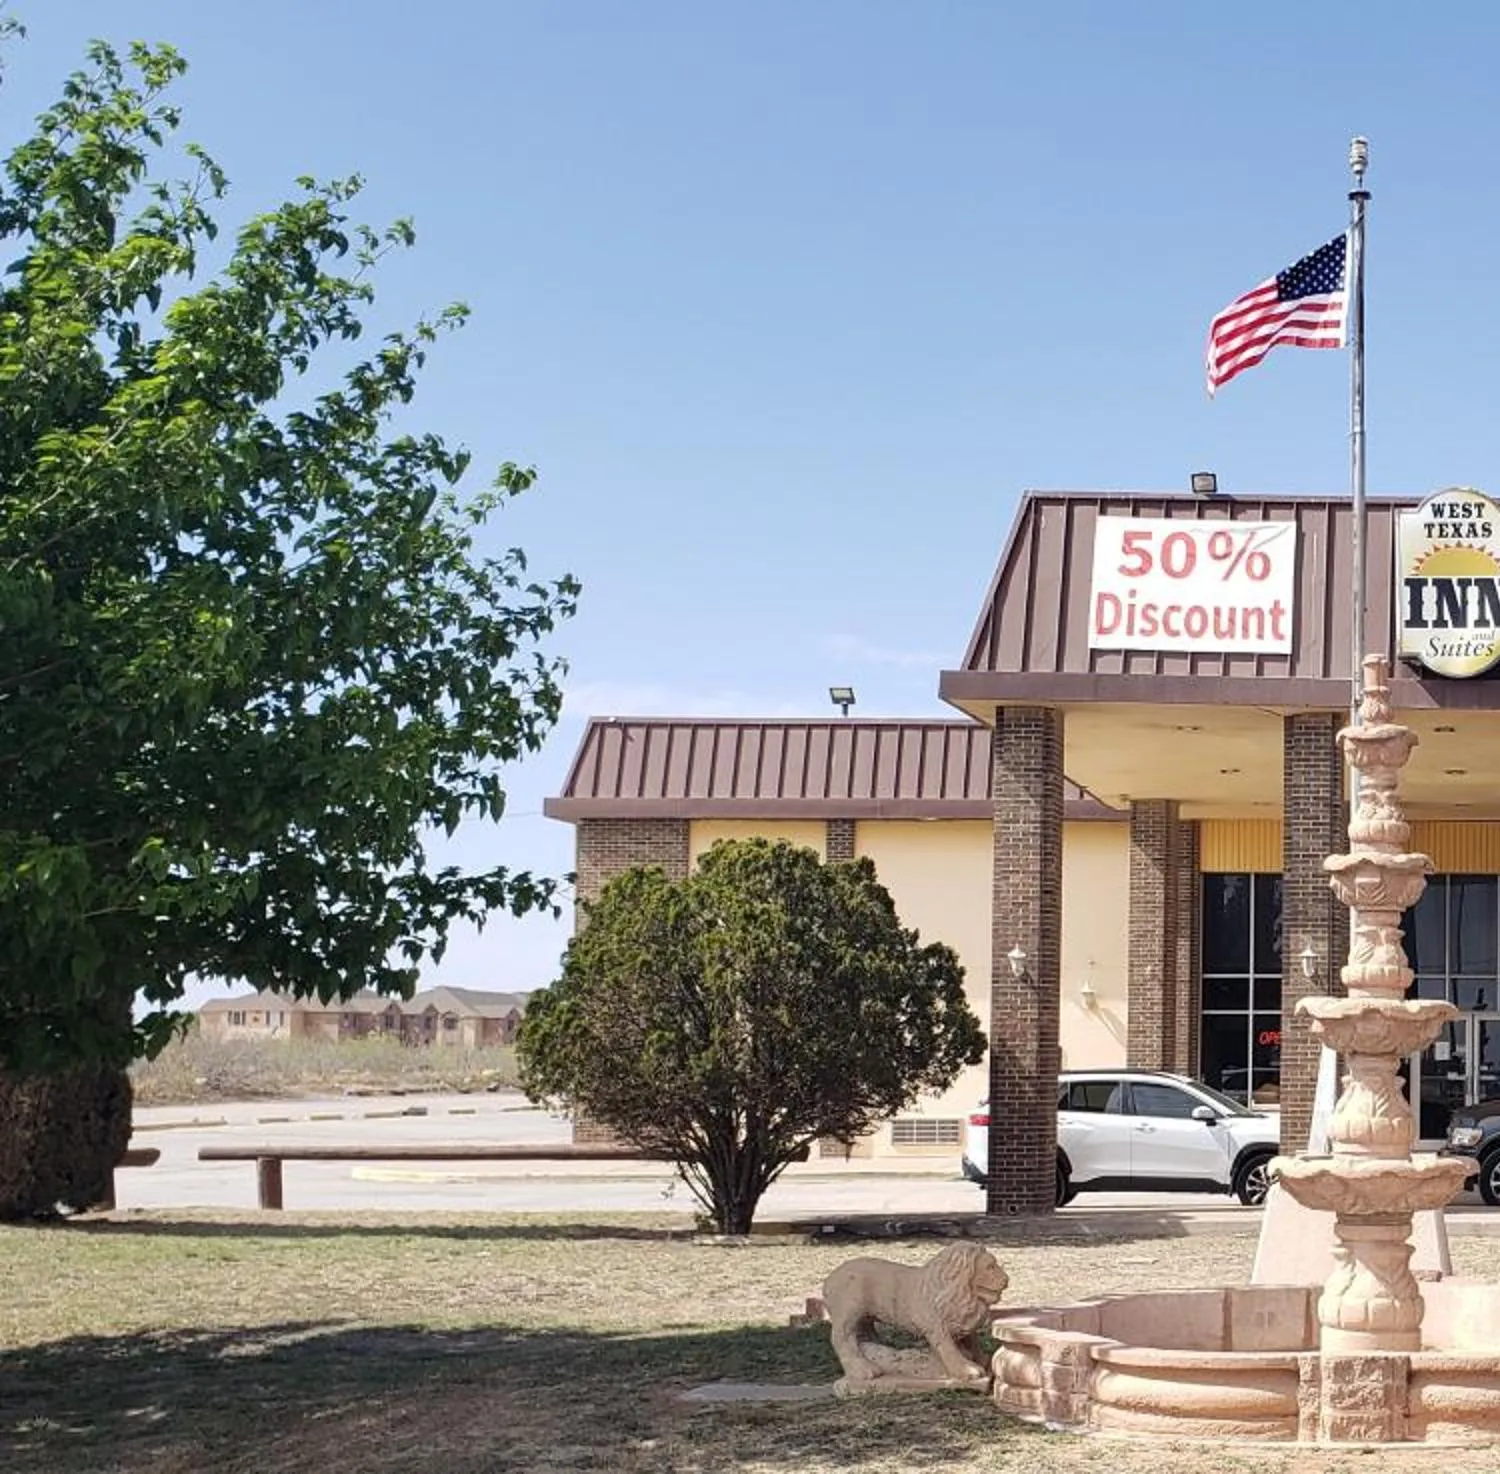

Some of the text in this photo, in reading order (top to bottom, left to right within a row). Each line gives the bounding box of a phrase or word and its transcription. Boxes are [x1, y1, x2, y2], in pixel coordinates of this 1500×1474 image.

[1431, 503, 1485, 519] WEST
[1424, 522, 1493, 539] TEXAS
[1117, 530, 1271, 581] 50%
[1095, 588, 1286, 640] Discount
[1427, 636, 1495, 657] Suites
[1259, 1031, 1281, 1045] OPE
